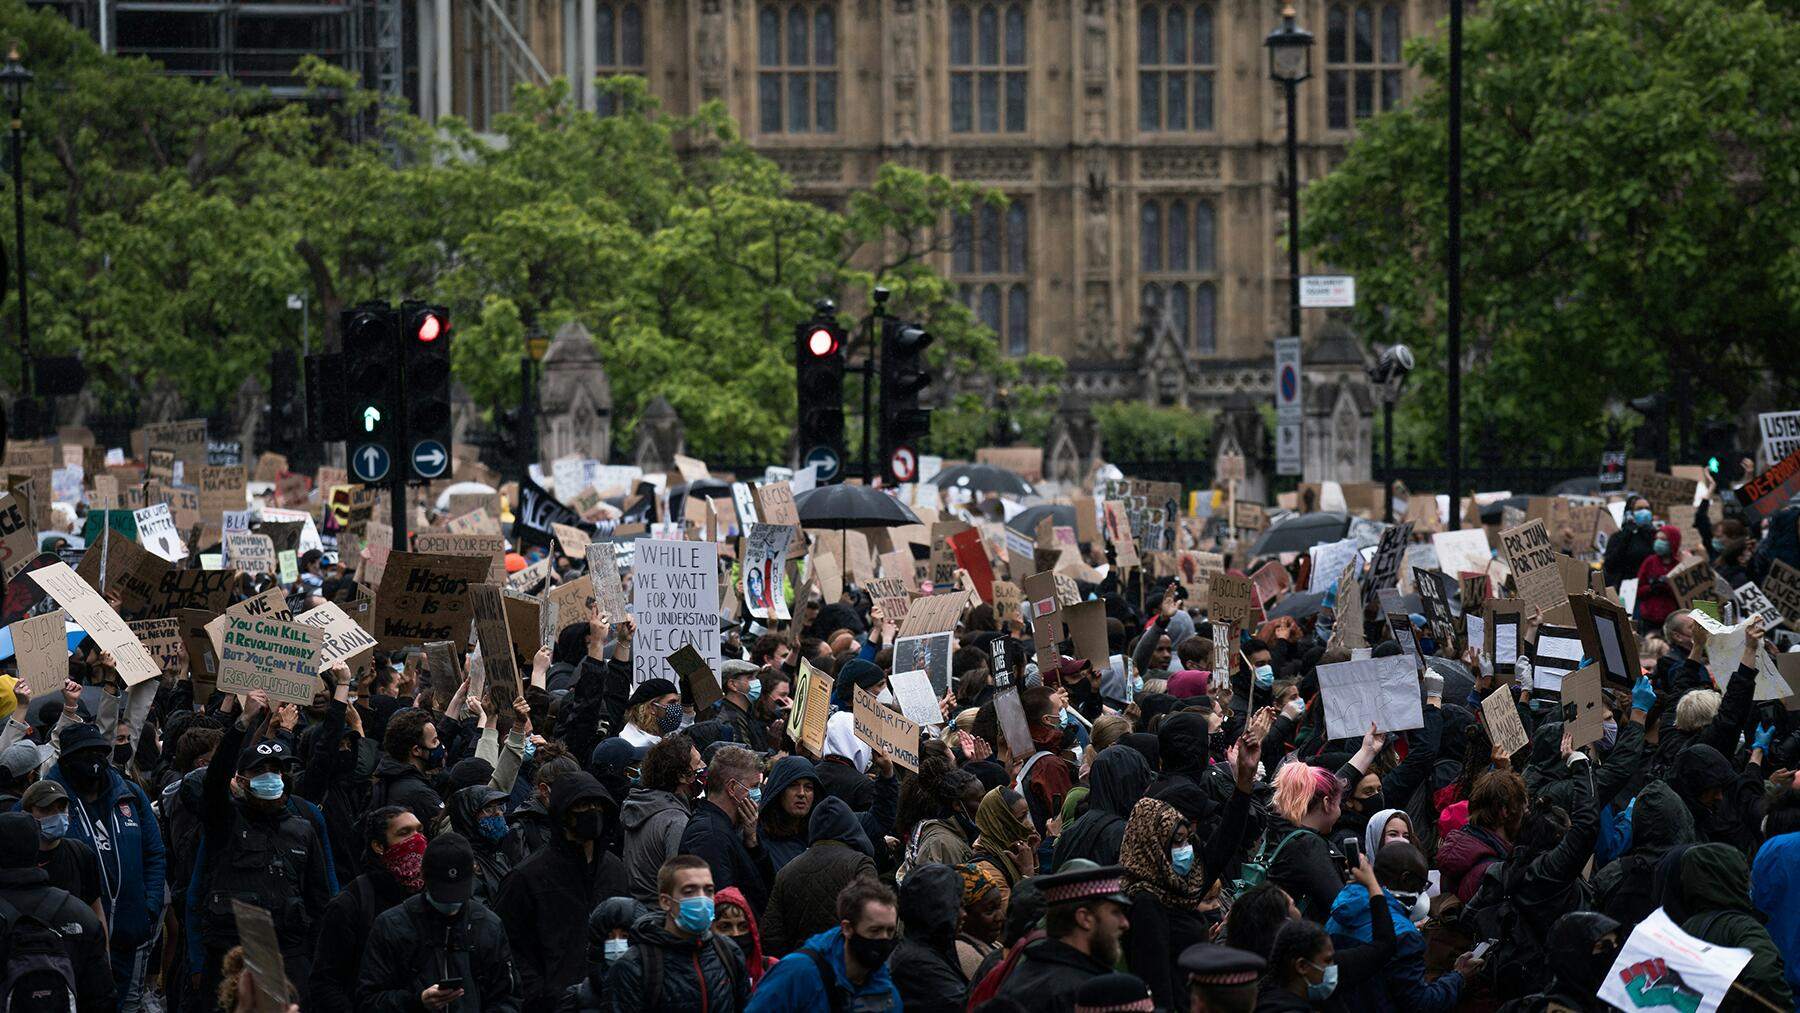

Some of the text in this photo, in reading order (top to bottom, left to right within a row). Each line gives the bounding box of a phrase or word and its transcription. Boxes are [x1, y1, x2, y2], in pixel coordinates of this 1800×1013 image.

[204, 479, 242, 492] NAMES
[136, 510, 151, 522] BLACK
[140, 517, 174, 537] MATTER
[419, 537, 503, 551] OPEN YOUR EYES
[1504, 523, 1550, 557] POR JUAN
[641, 545, 700, 568] WHILE
[1512, 557, 1532, 577] POR
[637, 572, 708, 590] WE WAIT
[1212, 579, 1251, 600] ABOLISH
[244, 595, 271, 616] WE
[646, 592, 697, 609] FOR YOU
[637, 611, 718, 626] TO UNDERSTAND
[22, 614, 65, 653] SILENCE
[148, 630, 175, 640] NEVER
[229, 616, 310, 644] YOU CAN KILL
[637, 629, 664, 651] WE
[225, 632, 315, 660] A REVOLUTIONARY
[223, 647, 244, 660] BUT
[244, 651, 265, 667] YOU
[297, 661, 317, 677] KILL
[255, 665, 273, 673] THE
[223, 667, 311, 699] REVOLUTION
[854, 690, 913, 735] SOLIDARITY
[854, 718, 874, 741] BLACK
